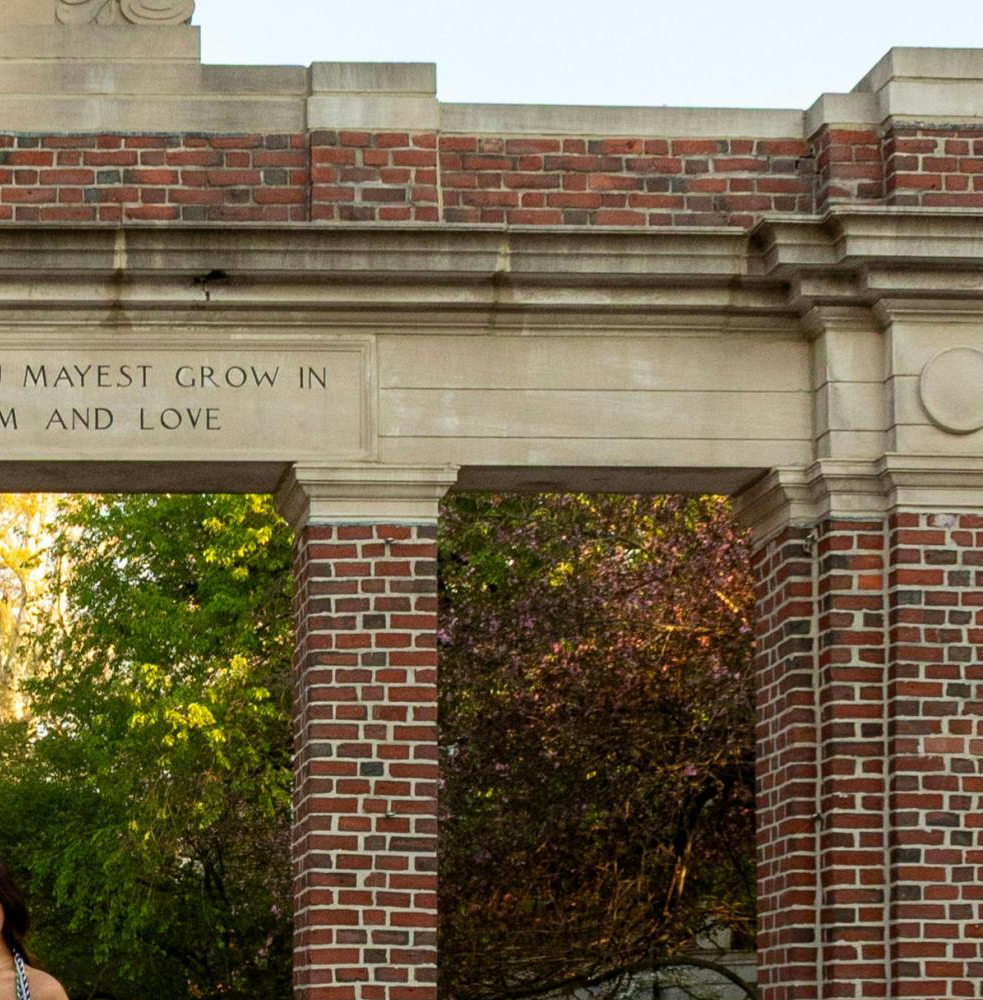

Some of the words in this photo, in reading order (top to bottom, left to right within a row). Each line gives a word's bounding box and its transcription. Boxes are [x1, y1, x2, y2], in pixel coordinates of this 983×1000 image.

[23, 365, 152, 388] MAYEST
[175, 366, 279, 388] GROW
[300, 367, 327, 389] IN
[46, 408, 113, 430] AND
[140, 408, 221, 430] LOVE
